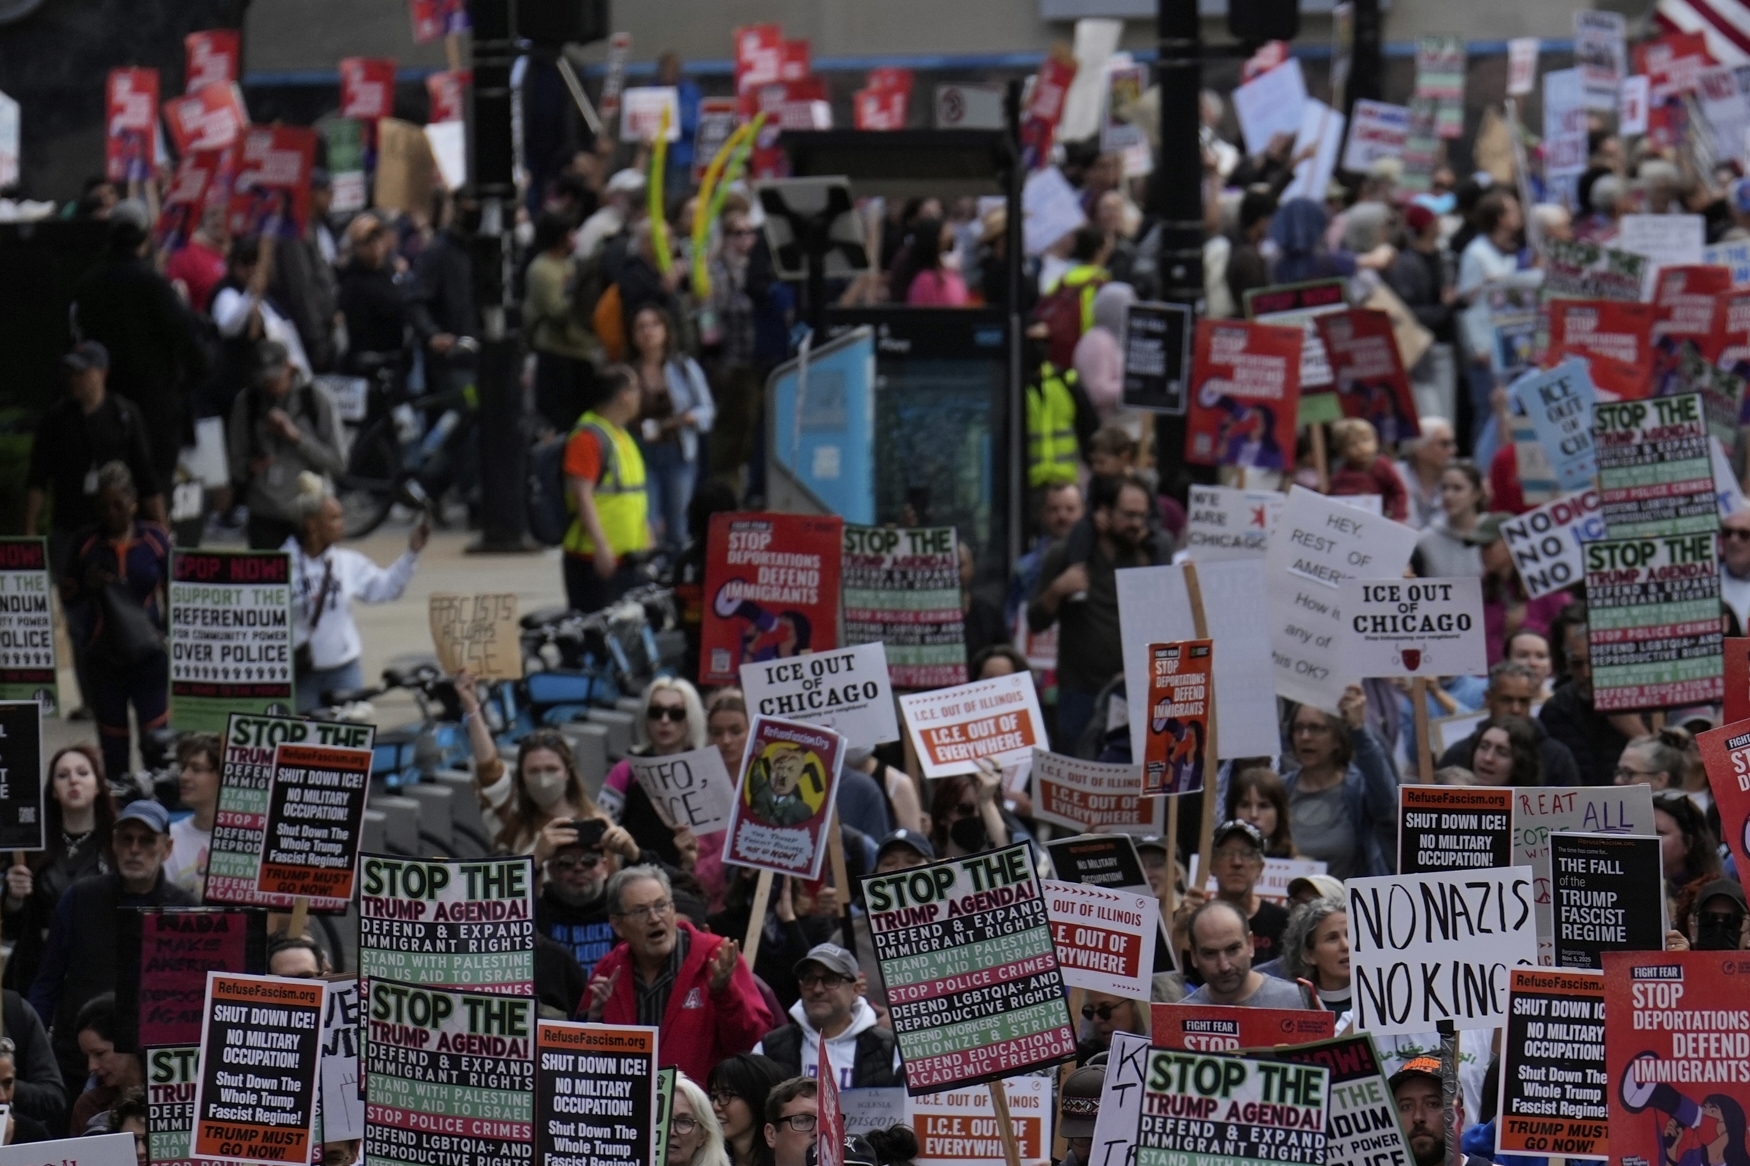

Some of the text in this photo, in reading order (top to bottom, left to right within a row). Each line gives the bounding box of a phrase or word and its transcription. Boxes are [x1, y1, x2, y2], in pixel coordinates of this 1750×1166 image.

[1291, 529, 1372, 568] REST OF
[173, 586, 286, 605] SUPPORT THE
[1363, 584, 1452, 602] ICE OUT
[173, 608, 287, 626] REFERENDUM
[1398, 603, 1418, 614] OF
[173, 629, 287, 640] FOR COMMUNITY POWER
[1353, 614, 1472, 633] CHICAGO
[173, 643, 287, 662] OVER POLICE
[766, 655, 855, 685] ICE OUT
[802, 677, 824, 691] OF
[759, 681, 879, 715] CHICAGO
[914, 691, 1025, 722] I.C.E. OUT OF ILLINOIS
[931, 715, 1018, 744] I.C.E. OUT OF
[935, 730, 1025, 762] EVERYWHERE
[1558, 857, 1624, 875] THE FALL
[1559, 876, 1586, 887] of the
[1560, 889, 1618, 907] TRUMP
[1350, 879, 1530, 952] NO NAZIS
[1561, 907, 1625, 925] FASCIST
[1561, 923, 1627, 943] REGIME
[218, 981, 316, 1003] RefuseFascism.org
[1355, 961, 1413, 1029] NO
[214, 1004, 315, 1029] SHUT DOWN ICE!
[371, 984, 529, 1037] STOP THE
[227, 1029, 301, 1051] NO MILITARY
[369, 1020, 530, 1060] TRUMP AGENDA!
[223, 1047, 300, 1069] OCCUPATION!
[369, 1044, 534, 1076] DEFEND & EXPAND
[216, 1071, 301, 1092] Shut Down The
[368, 1058, 534, 1091] IMMIGRANT RIGHTS
[220, 1088, 295, 1111] Whole Trump
[209, 1103, 302, 1126] Fascist Regime!
[367, 1106, 531, 1138] STOP POLICE CRIMES
[203, 1125, 304, 1146] TRUMP MUST
[219, 1143, 286, 1160] GO NOW!
